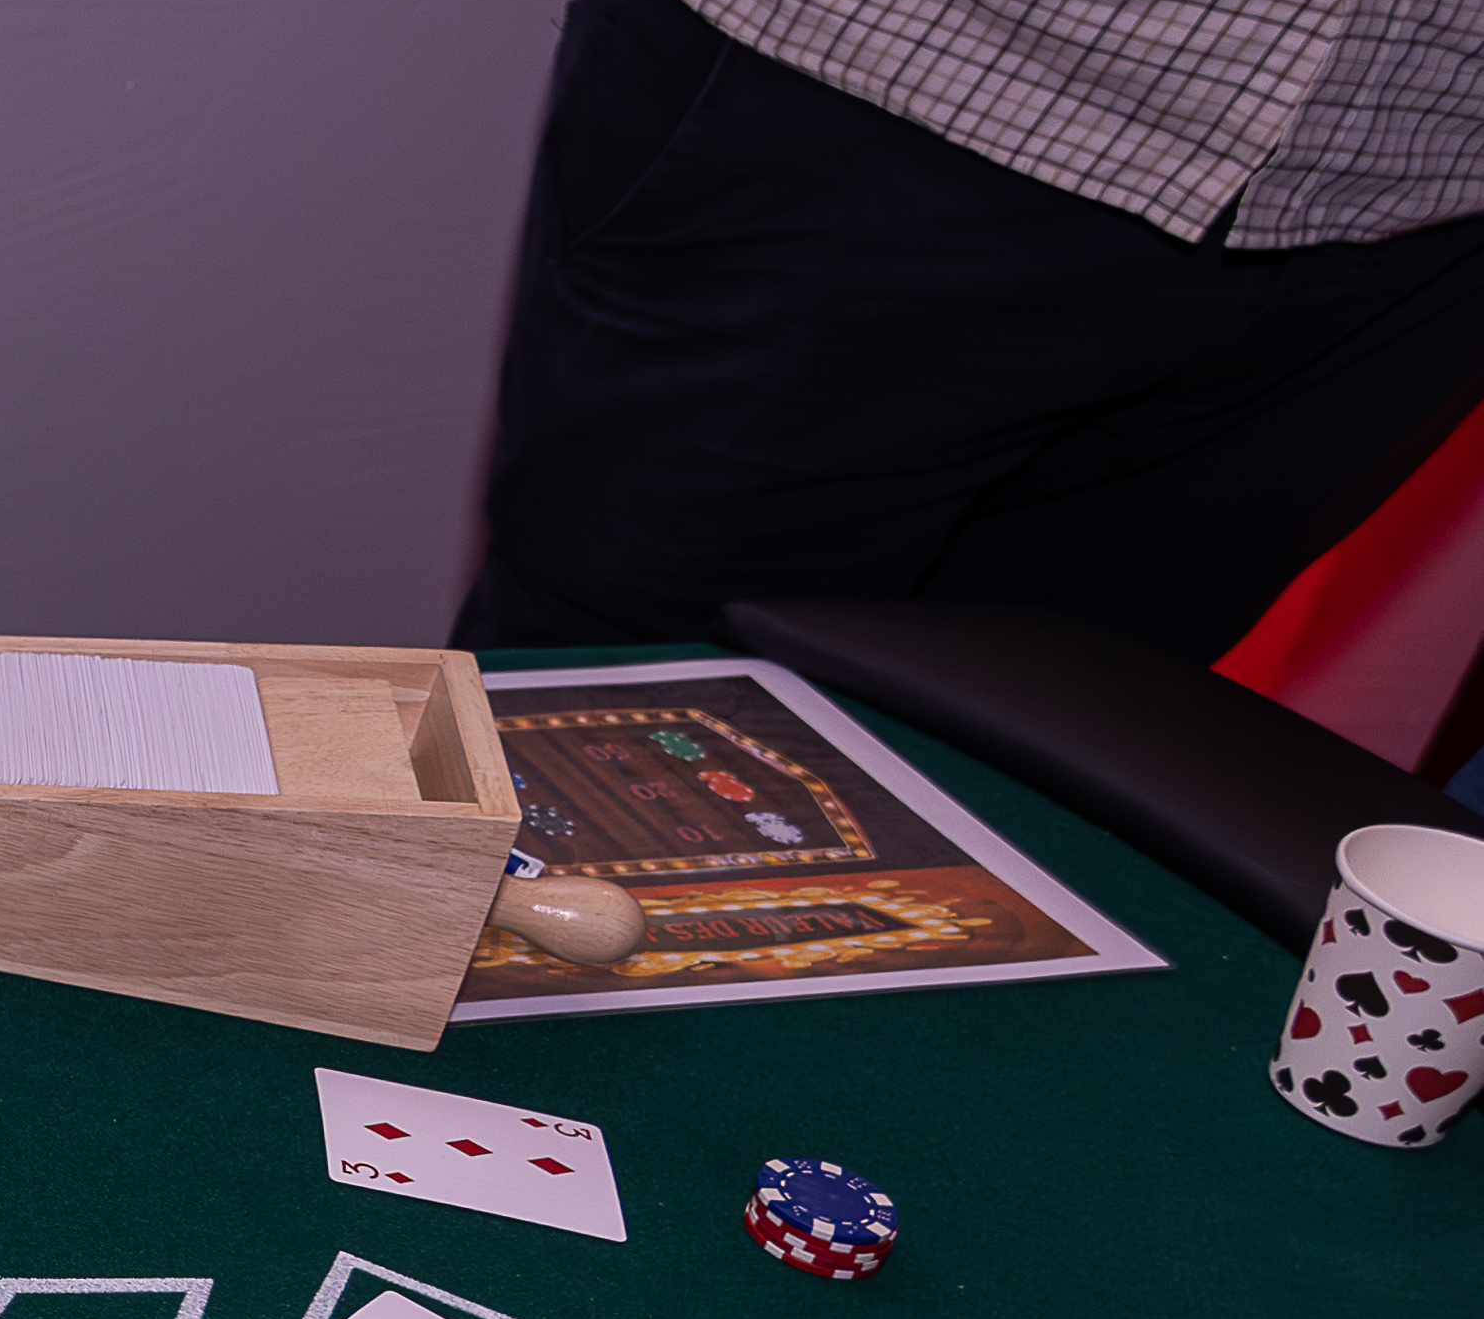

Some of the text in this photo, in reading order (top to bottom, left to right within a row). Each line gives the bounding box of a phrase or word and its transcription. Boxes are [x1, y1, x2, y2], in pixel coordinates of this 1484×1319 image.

[629, 782, 677, 800] 20
[677, 825, 724, 843] 10
[664, 919, 739, 941] DES
[738, 909, 885, 936] VALEUR
[554, 1123, 592, 1141] 3
[341, 1160, 379, 1179] 3
